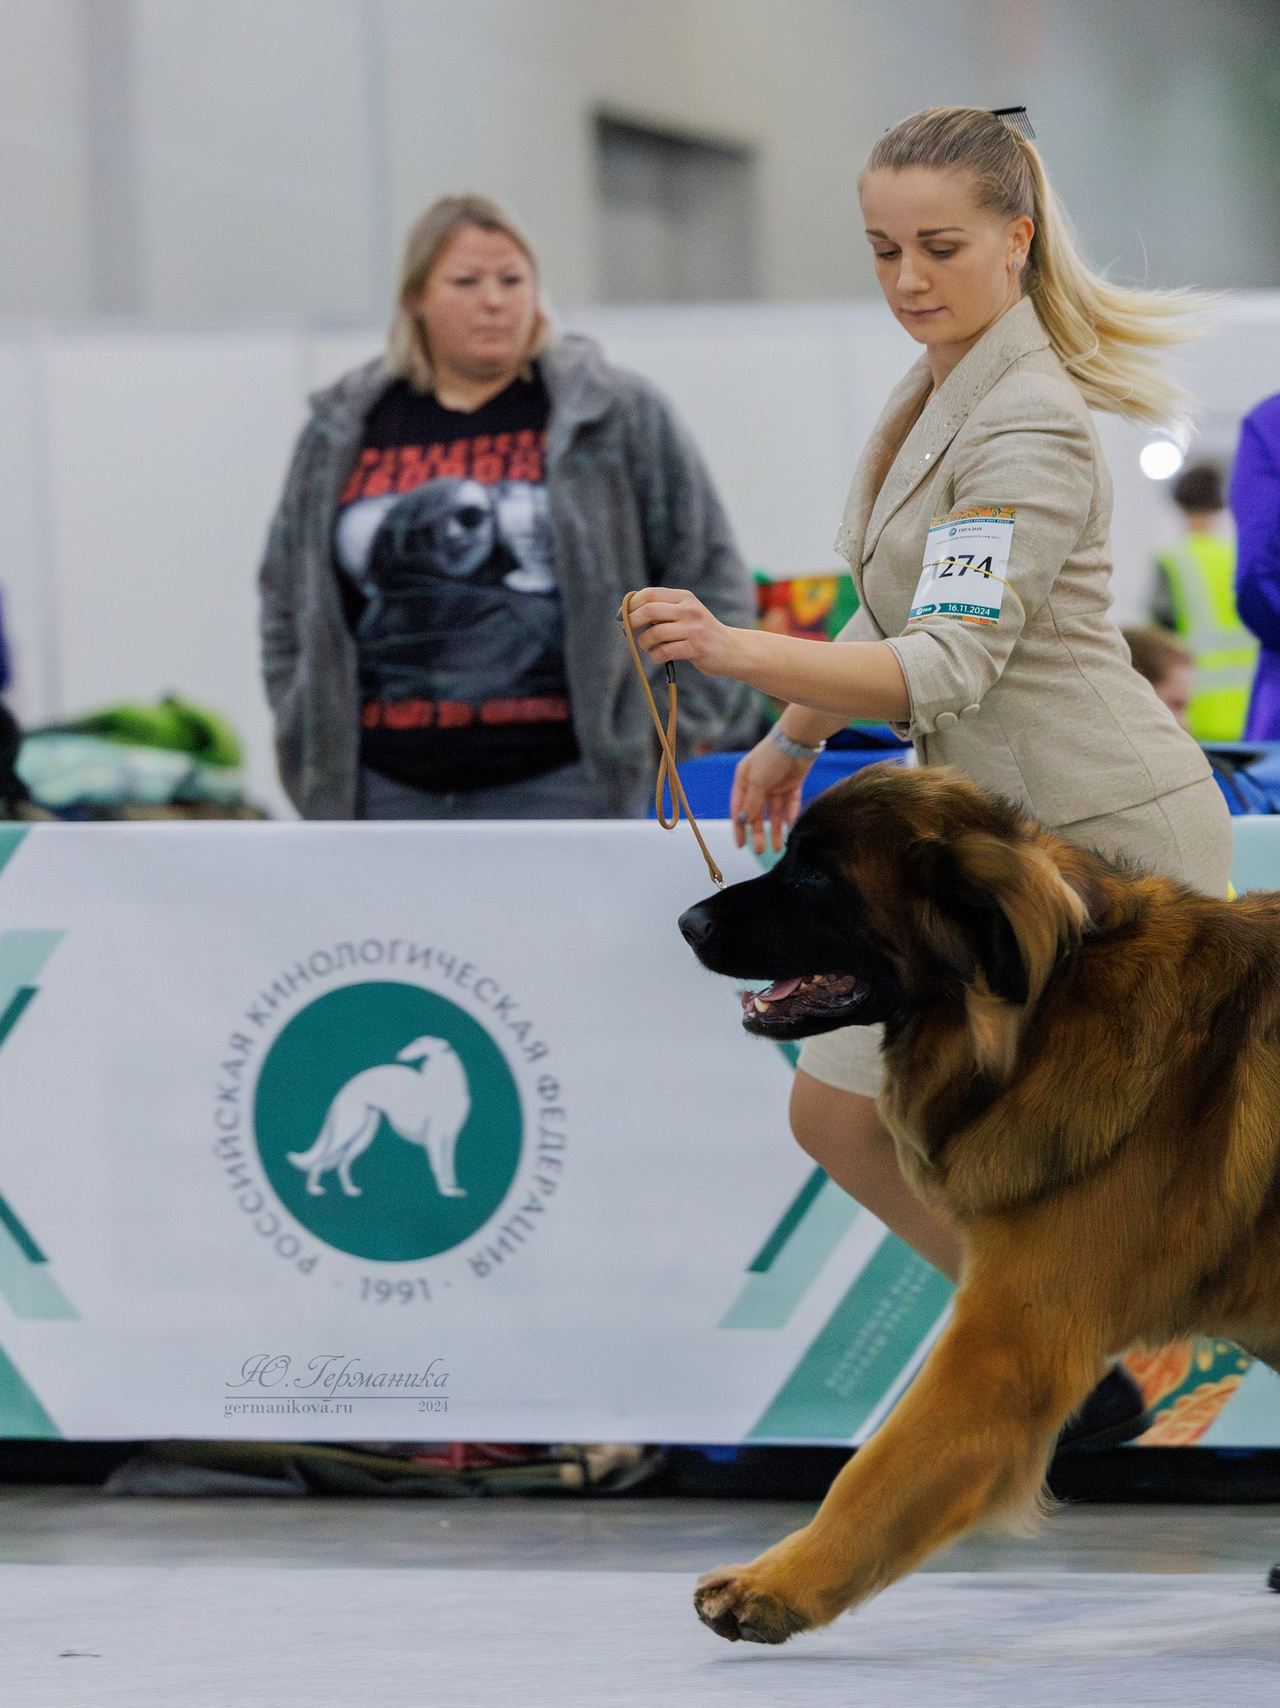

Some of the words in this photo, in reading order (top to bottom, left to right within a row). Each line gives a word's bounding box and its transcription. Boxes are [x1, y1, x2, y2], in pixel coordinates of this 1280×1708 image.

[948, 603, 991, 616] 16.11.2024
[244, 938, 550, 1064] КИНОЛОГИЧЕСКАЯ
[213, 1031, 320, 1275] РОССИЙСКАЯ
[467, 1074, 566, 1279] ФЕДЕРАЦИЯ
[360, 1276, 432, 1302] 1991
